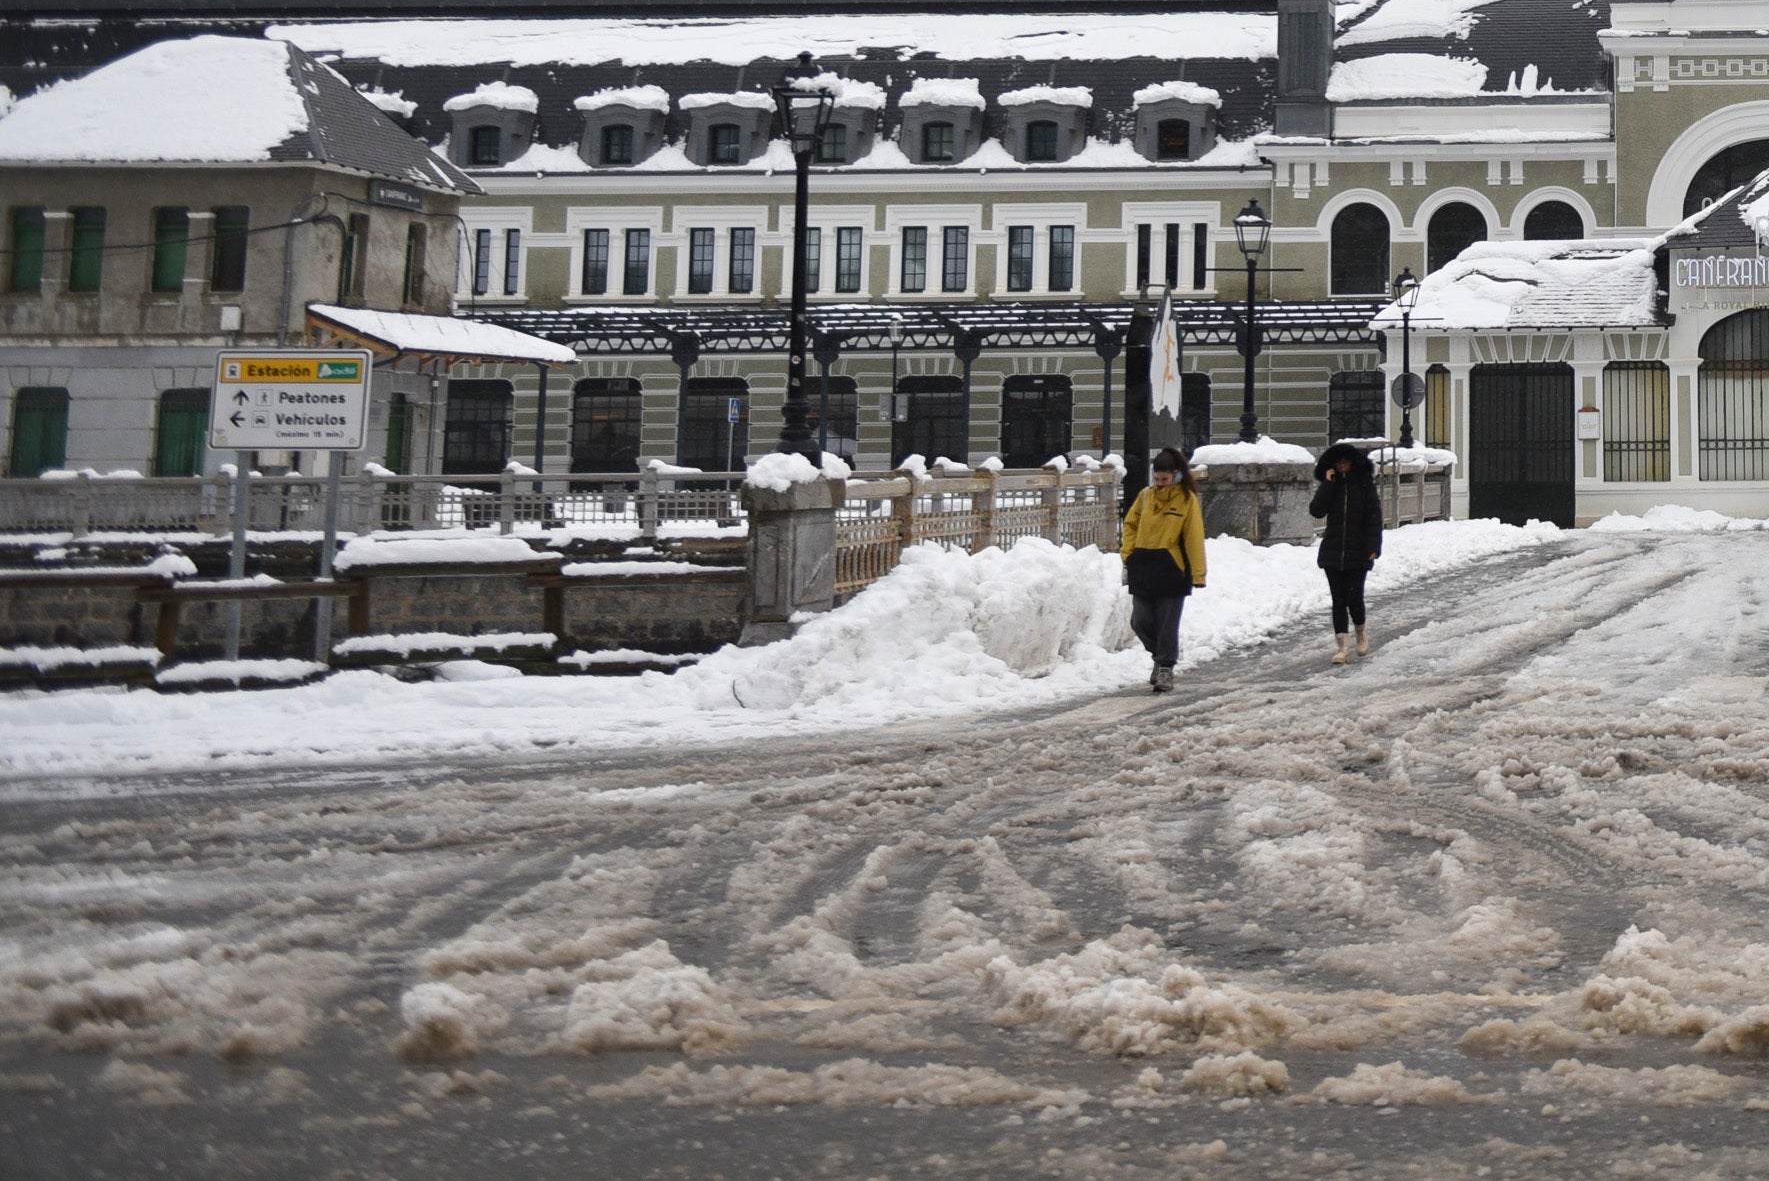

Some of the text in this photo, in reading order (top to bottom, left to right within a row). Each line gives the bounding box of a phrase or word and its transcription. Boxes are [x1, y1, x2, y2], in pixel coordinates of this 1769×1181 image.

[1703, 302, 1709, 310] A
[1714, 301, 1748, 310] ROYAL
[248, 364, 310, 377] Estación
[279, 392, 346, 404] Peatones
